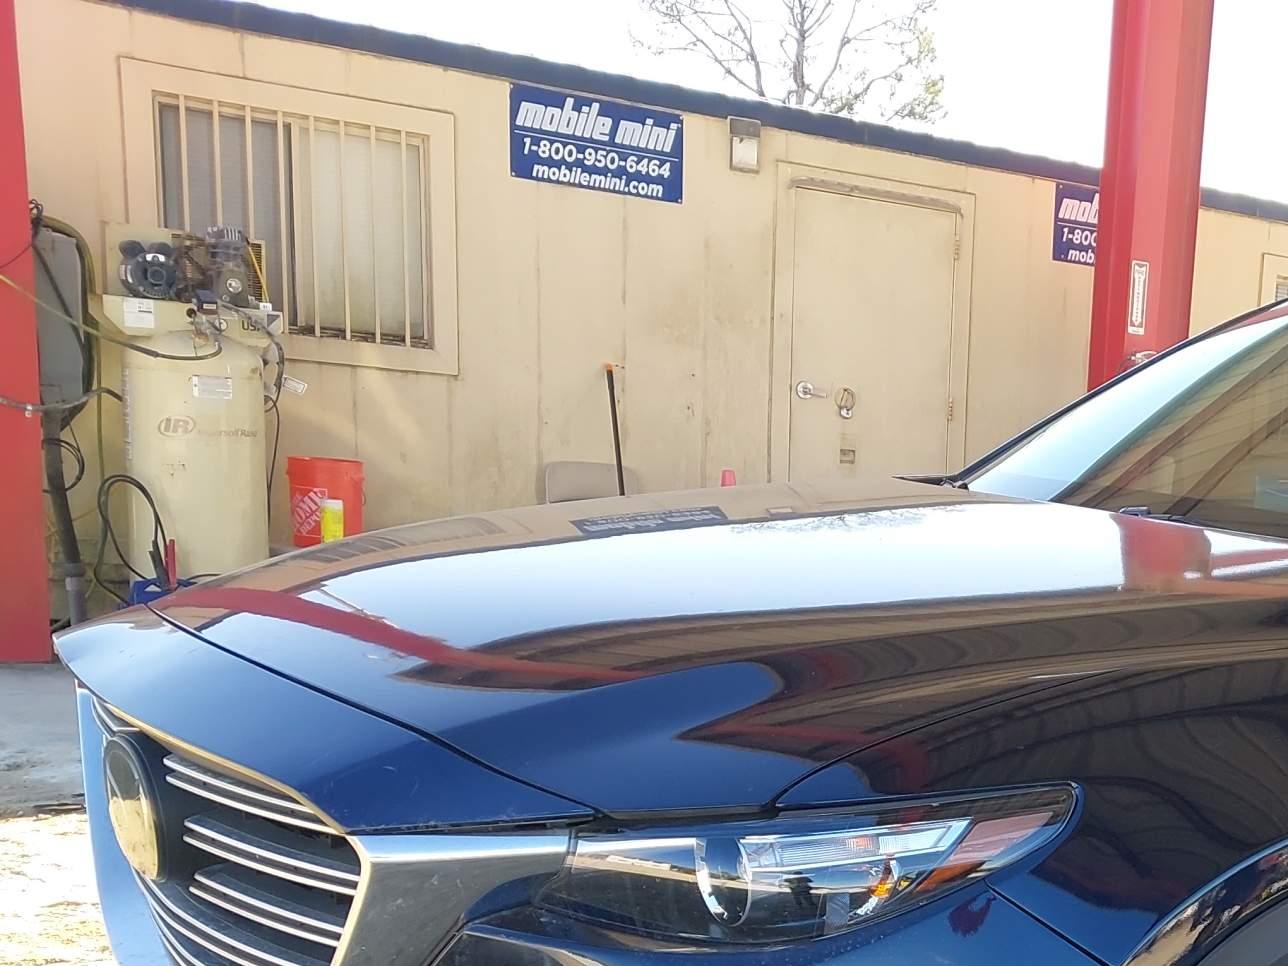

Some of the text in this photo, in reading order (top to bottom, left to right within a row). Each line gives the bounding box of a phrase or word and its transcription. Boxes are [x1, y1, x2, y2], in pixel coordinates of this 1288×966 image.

[515, 97, 678, 153] mobile mini
[523, 137, 671, 179] 1-800-950-6464
[532, 163, 663, 197] mobilemini.com
